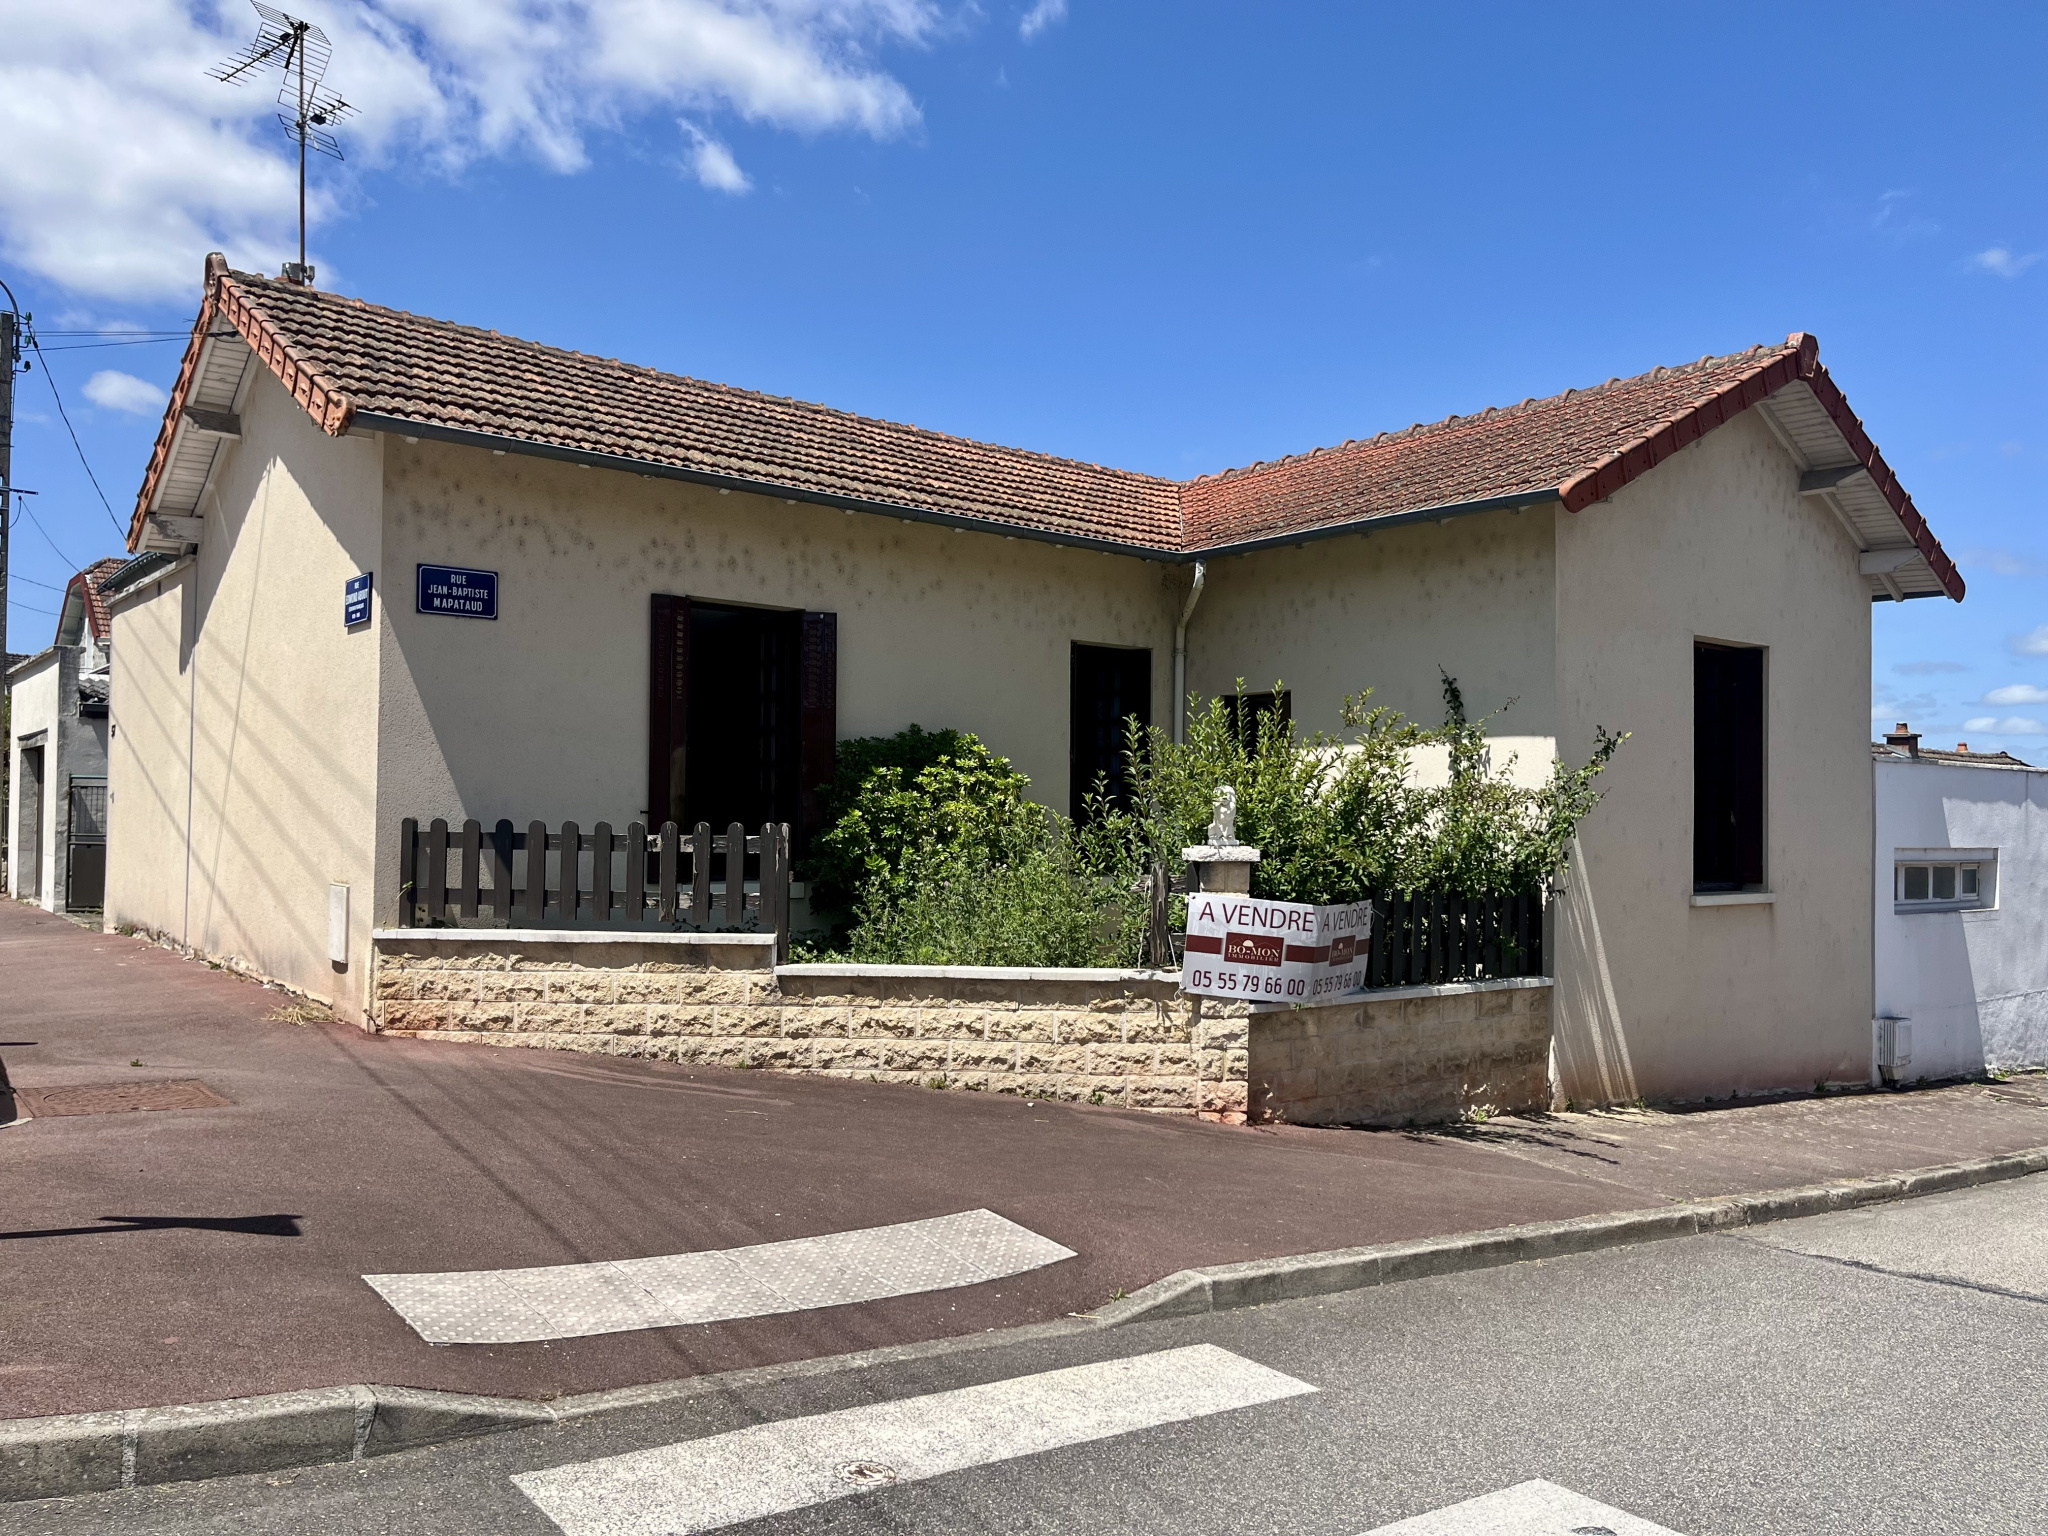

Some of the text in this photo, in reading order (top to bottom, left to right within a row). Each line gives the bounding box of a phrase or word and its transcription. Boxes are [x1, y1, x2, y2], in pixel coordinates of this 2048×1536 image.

[450, 574, 467, 585] RUE
[427, 584, 489, 599] JEAN-BAPTISTE
[433, 597, 483, 612] MAPATAUD
[1199, 901, 1315, 933] A VENDRE
[1321, 906, 1368, 933] A VENDRE
[1227, 953, 1279, 963] IMMOBILIER
[1228, 944, 1280, 958] BO-MON
[1192, 969, 1305, 996] 05 55 79 66 00
[1312, 970, 1362, 996] 05 55 79 66 00
